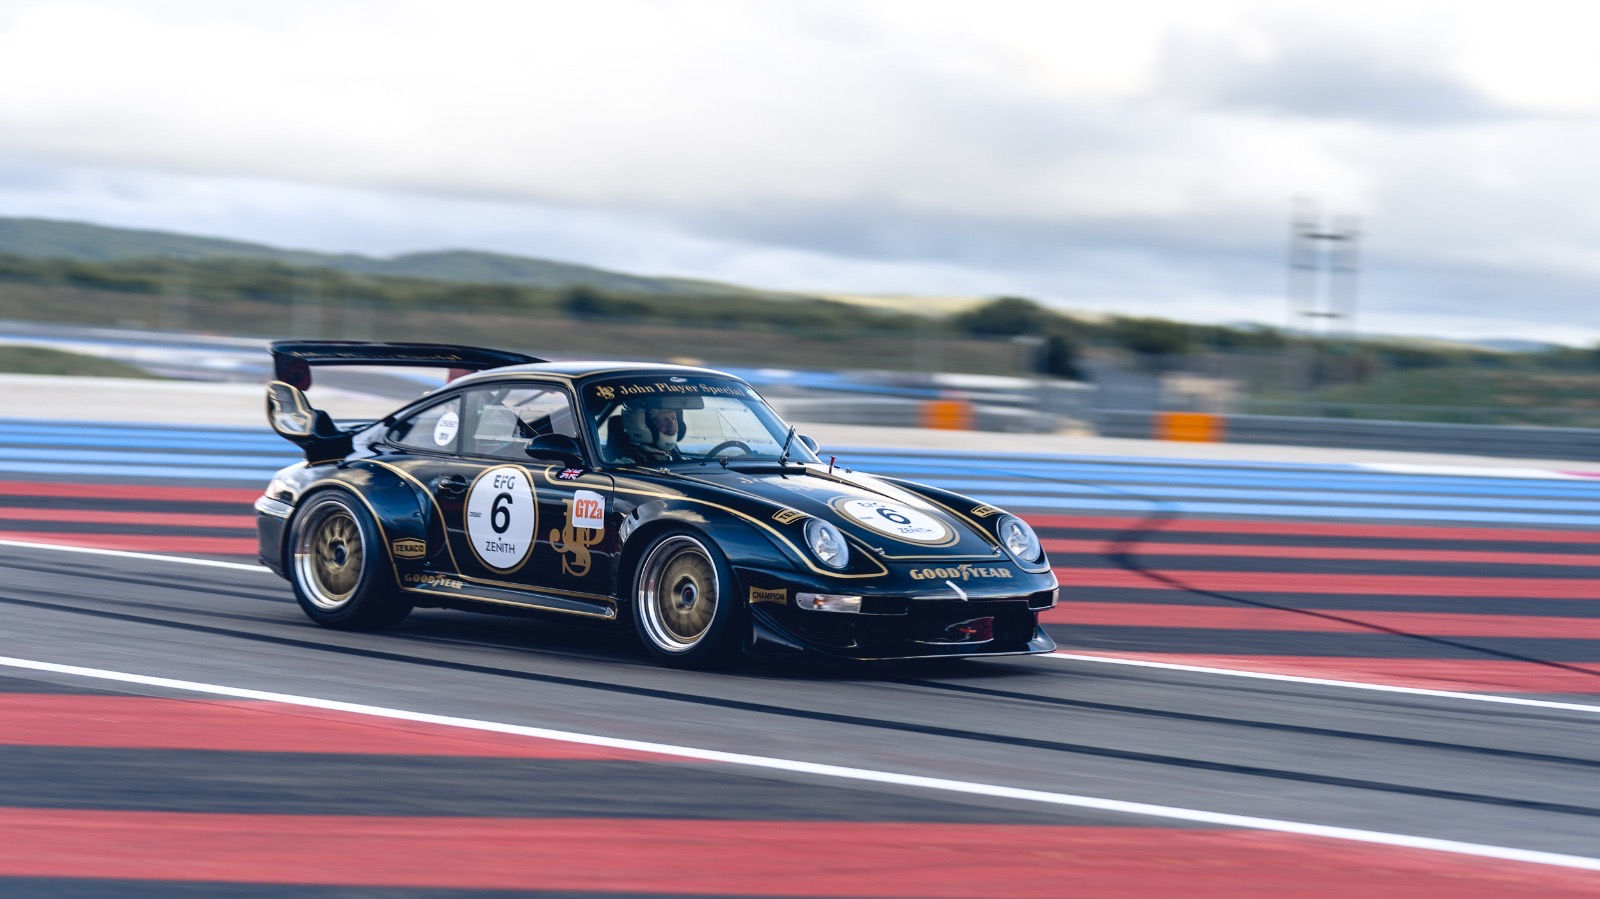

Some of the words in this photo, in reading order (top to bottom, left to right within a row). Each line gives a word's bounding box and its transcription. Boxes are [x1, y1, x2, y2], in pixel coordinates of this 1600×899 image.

[620, 384, 655, 394] John
[654, 383, 698, 394] Player
[699, 384, 745, 396] Special
[493, 474, 516, 490] EFG
[490, 491, 513, 534] 6
[575, 499, 603, 520] GT2a
[876, 507, 911, 525] 6
[395, 544, 424, 553] TEXACO
[485, 541, 516, 554] ZENITH
[751, 591, 786, 601] CHAMPION
